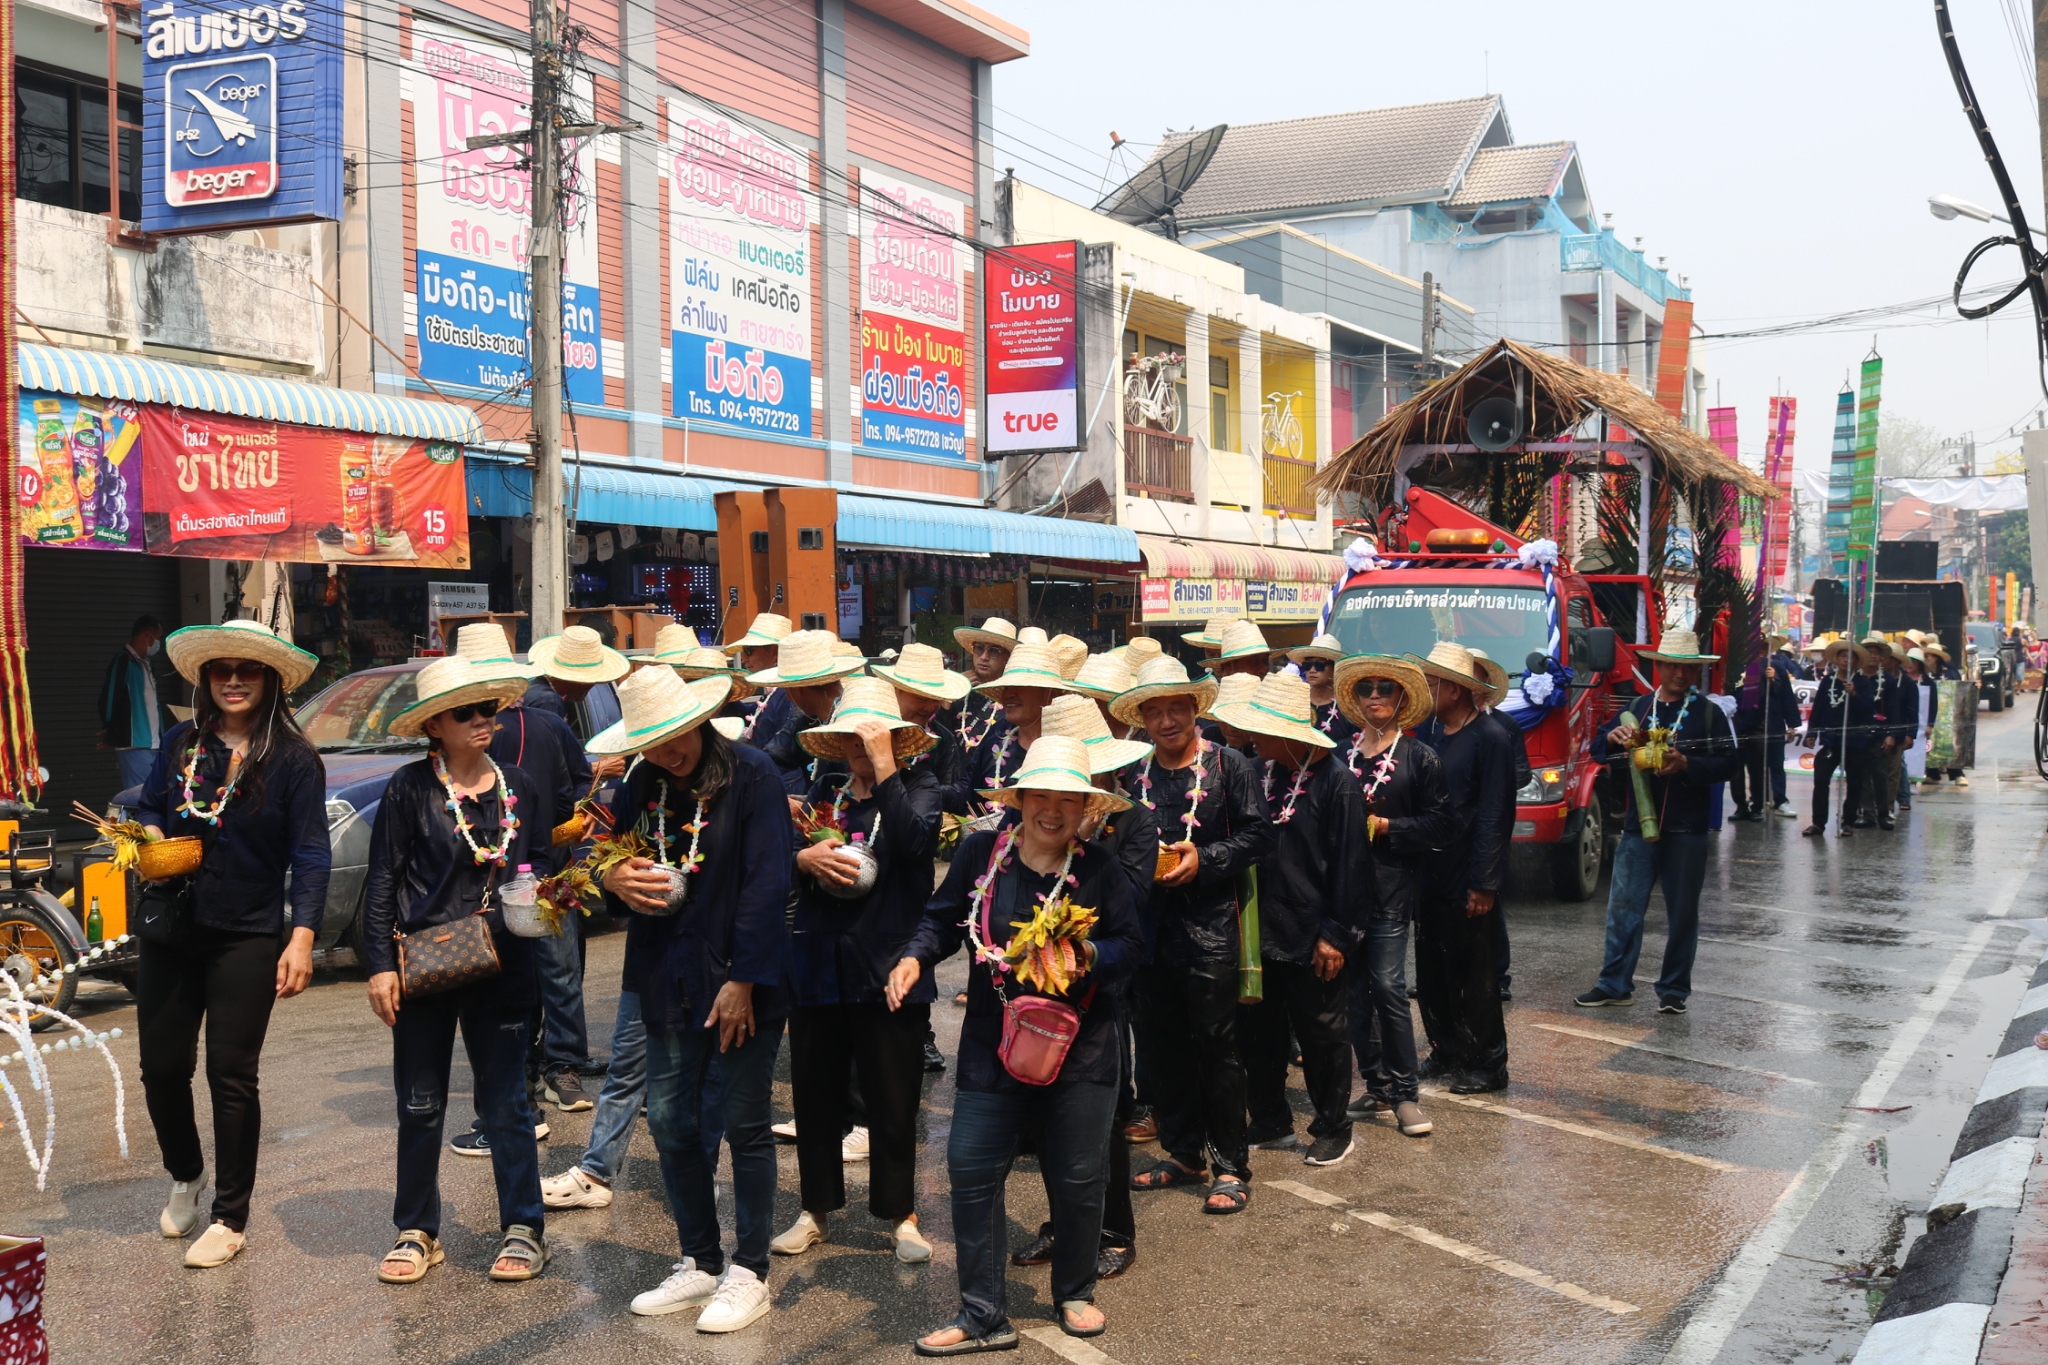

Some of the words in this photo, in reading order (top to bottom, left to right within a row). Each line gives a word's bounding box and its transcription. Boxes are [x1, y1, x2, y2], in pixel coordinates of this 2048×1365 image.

[220, 84, 267, 101] beger
[176, 129, 200, 141] B-52
[186, 170, 257, 195] beger
[679, 218, 732, 255] หน้าจอ
[739, 239, 803, 276] แบตเตอรี่
[877, 225, 951, 282] ซ่อมด่วน
[685, 258, 719, 292] ฟิล์ม
[732, 277, 800, 313] เคสมือถือ
[870, 269, 957, 316] มีช่าง-มีอะไหล่
[1001, 291, 1060, 312] โมบาย
[426, 317, 524, 356] ใช้บัตรประชาชน
[681, 297, 727, 334] ลำโพง
[740, 319, 803, 352] สายชาร์จ
[862, 317, 889, 351] ร้าน
[925, 332, 962, 367] โมบาย
[706, 341, 783, 404] มือถือ
[864, 356, 961, 416] ผ่อนมือถือ
[689, 391, 715, 415] โทร.
[719, 399, 799, 431] 094-9572728
[1003, 411, 1058, 433] true
[182, 424, 209, 446] ใหม่
[236, 424, 277, 445] เนเจอรี่
[864, 418, 882, 440] โทร.
[885, 424, 939, 449] 094-9572728
[176, 434, 279, 492] ชาไทย
[177, 507, 285, 532] เต็มรสชาติชาไทยแท้
[423, 510, 446, 533] 15
[427, 535, 444, 545] บาท
[441, 585, 476, 594] SAMSUNG
[431, 601, 452, 610] Galaxy
